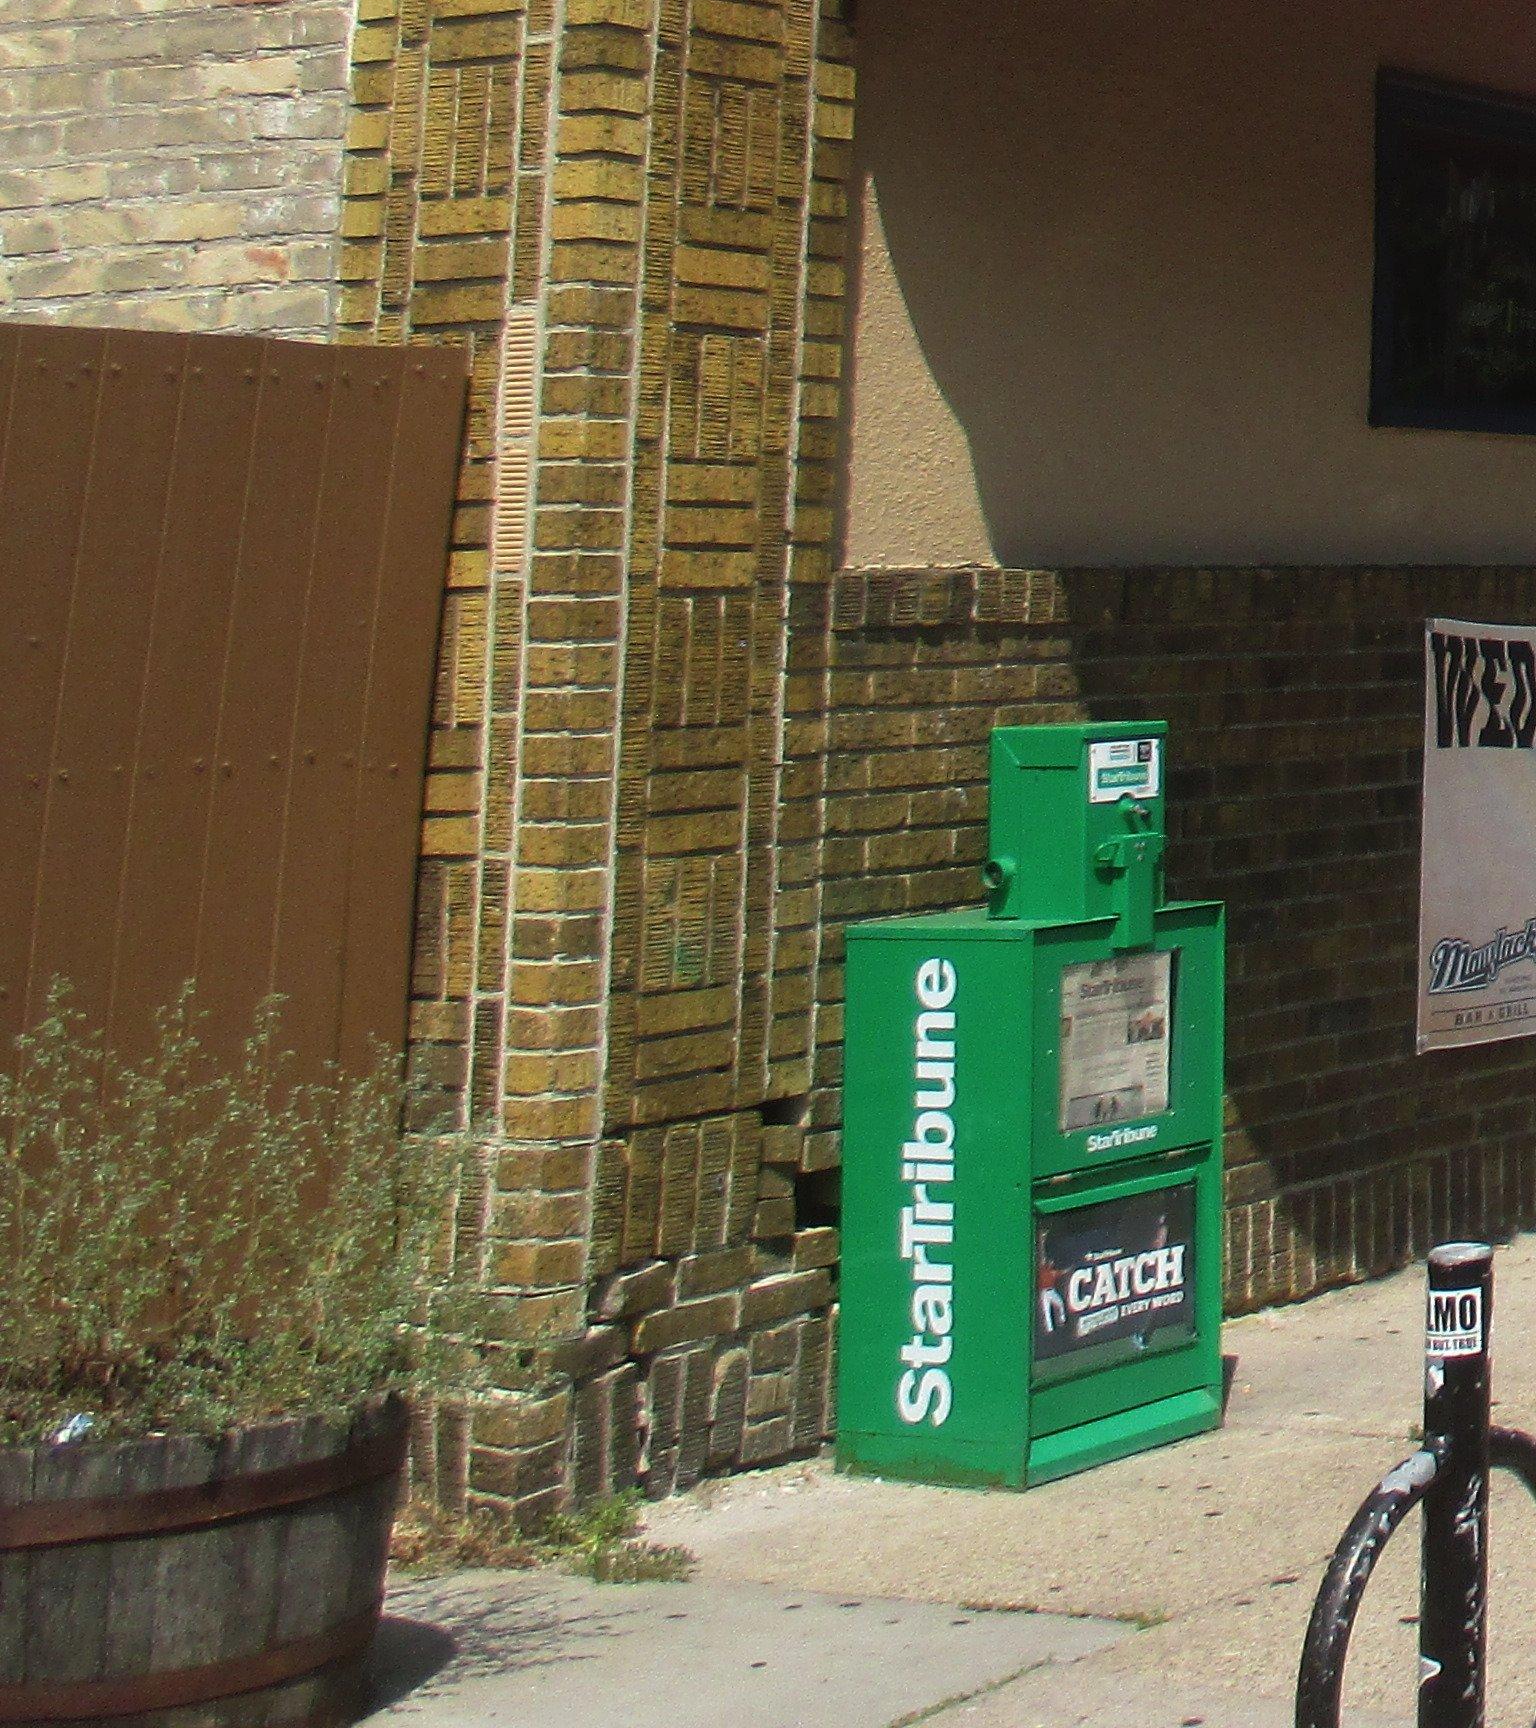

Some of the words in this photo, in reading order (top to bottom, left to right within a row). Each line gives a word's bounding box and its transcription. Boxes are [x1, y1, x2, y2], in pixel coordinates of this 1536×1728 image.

[1086, 1125, 1159, 1153] StarTribune
[897, 957, 958, 1428] StarTribune
[1067, 1244, 1186, 1313] CATCH
